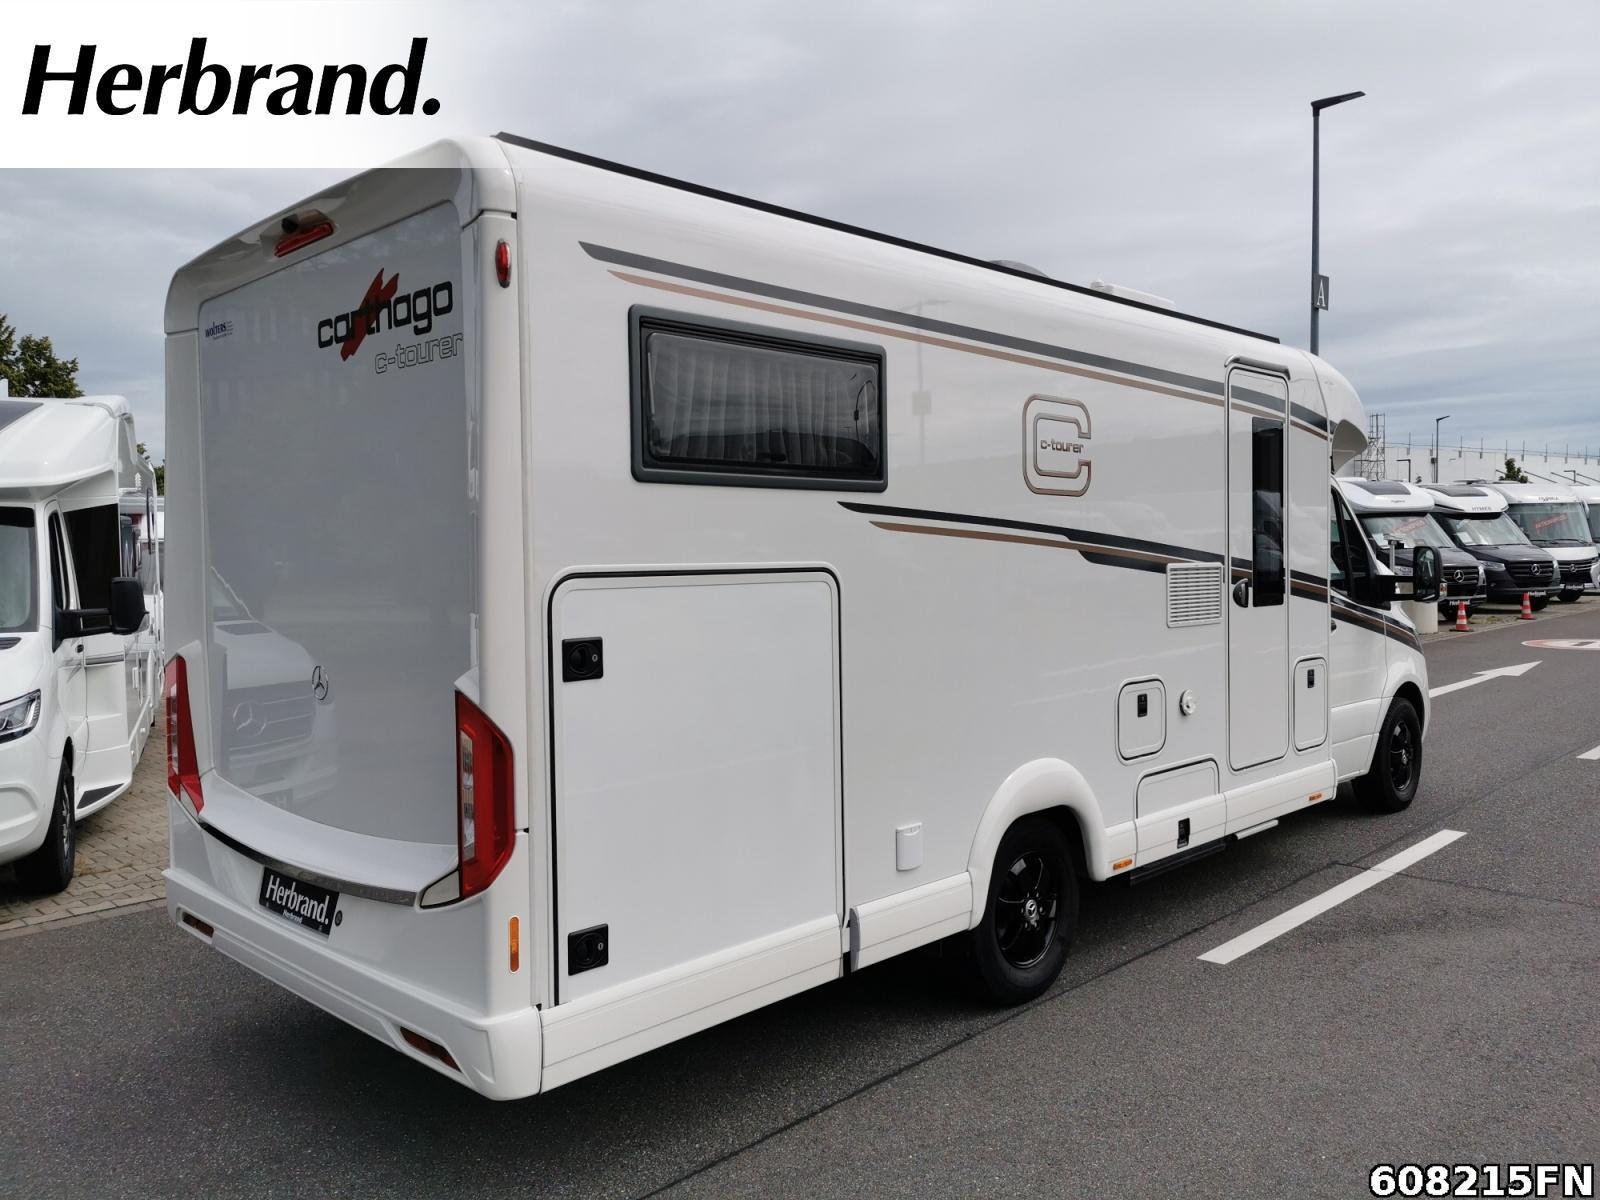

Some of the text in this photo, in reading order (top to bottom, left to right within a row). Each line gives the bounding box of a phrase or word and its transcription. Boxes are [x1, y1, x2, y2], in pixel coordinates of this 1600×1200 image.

[1316, 279, 1326, 307] A
[317, 280, 454, 349] carthago
[375, 332, 464, 374] c-tourer
[1040, 438, 1085, 454] c-tourer
[265, 874, 330, 925] Herbrand.
